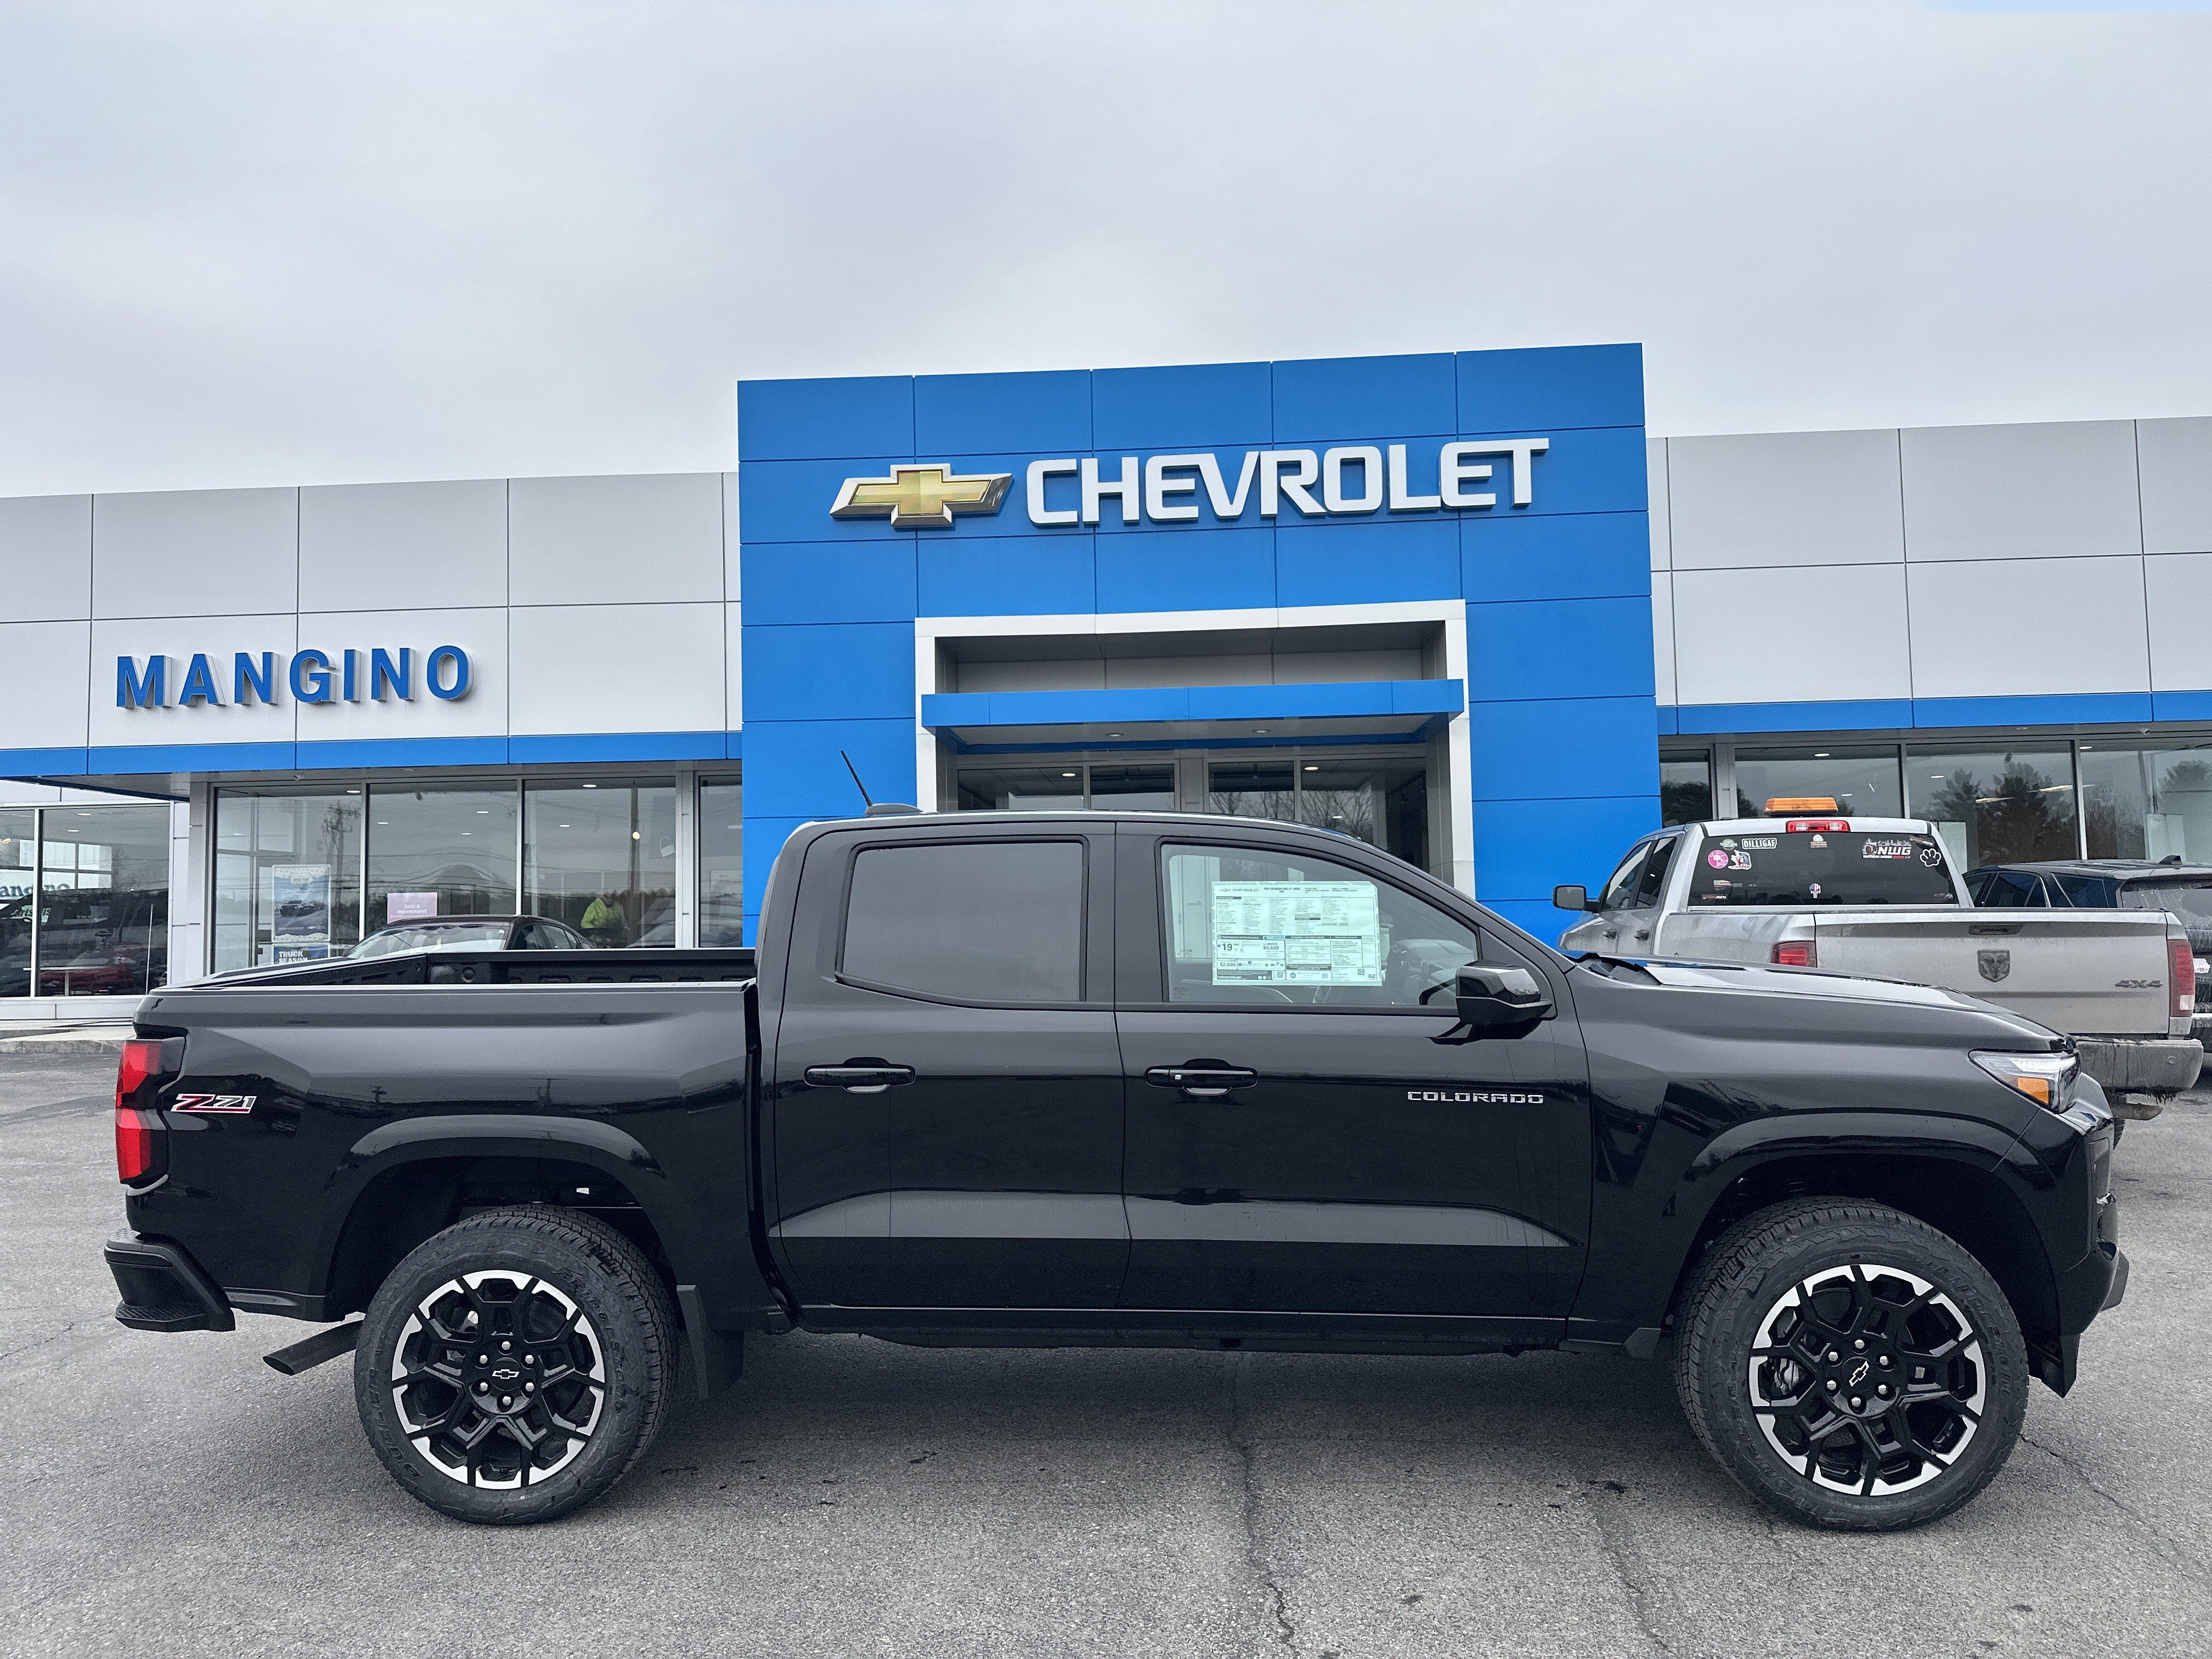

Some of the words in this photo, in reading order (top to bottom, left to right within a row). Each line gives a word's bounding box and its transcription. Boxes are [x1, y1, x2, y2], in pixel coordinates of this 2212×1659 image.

[1026, 438, 1549, 527] CHEVROLET
[116, 645, 474, 708] MANGINO
[1743, 839, 1776, 848] DILLIGAF
[1877, 847, 1911, 855] NWG
[171, 1093, 257, 1114] Z71
[1407, 1091, 1544, 1104] COLORADO
[551, 1266, 628, 1417] BRIDGESTONE
